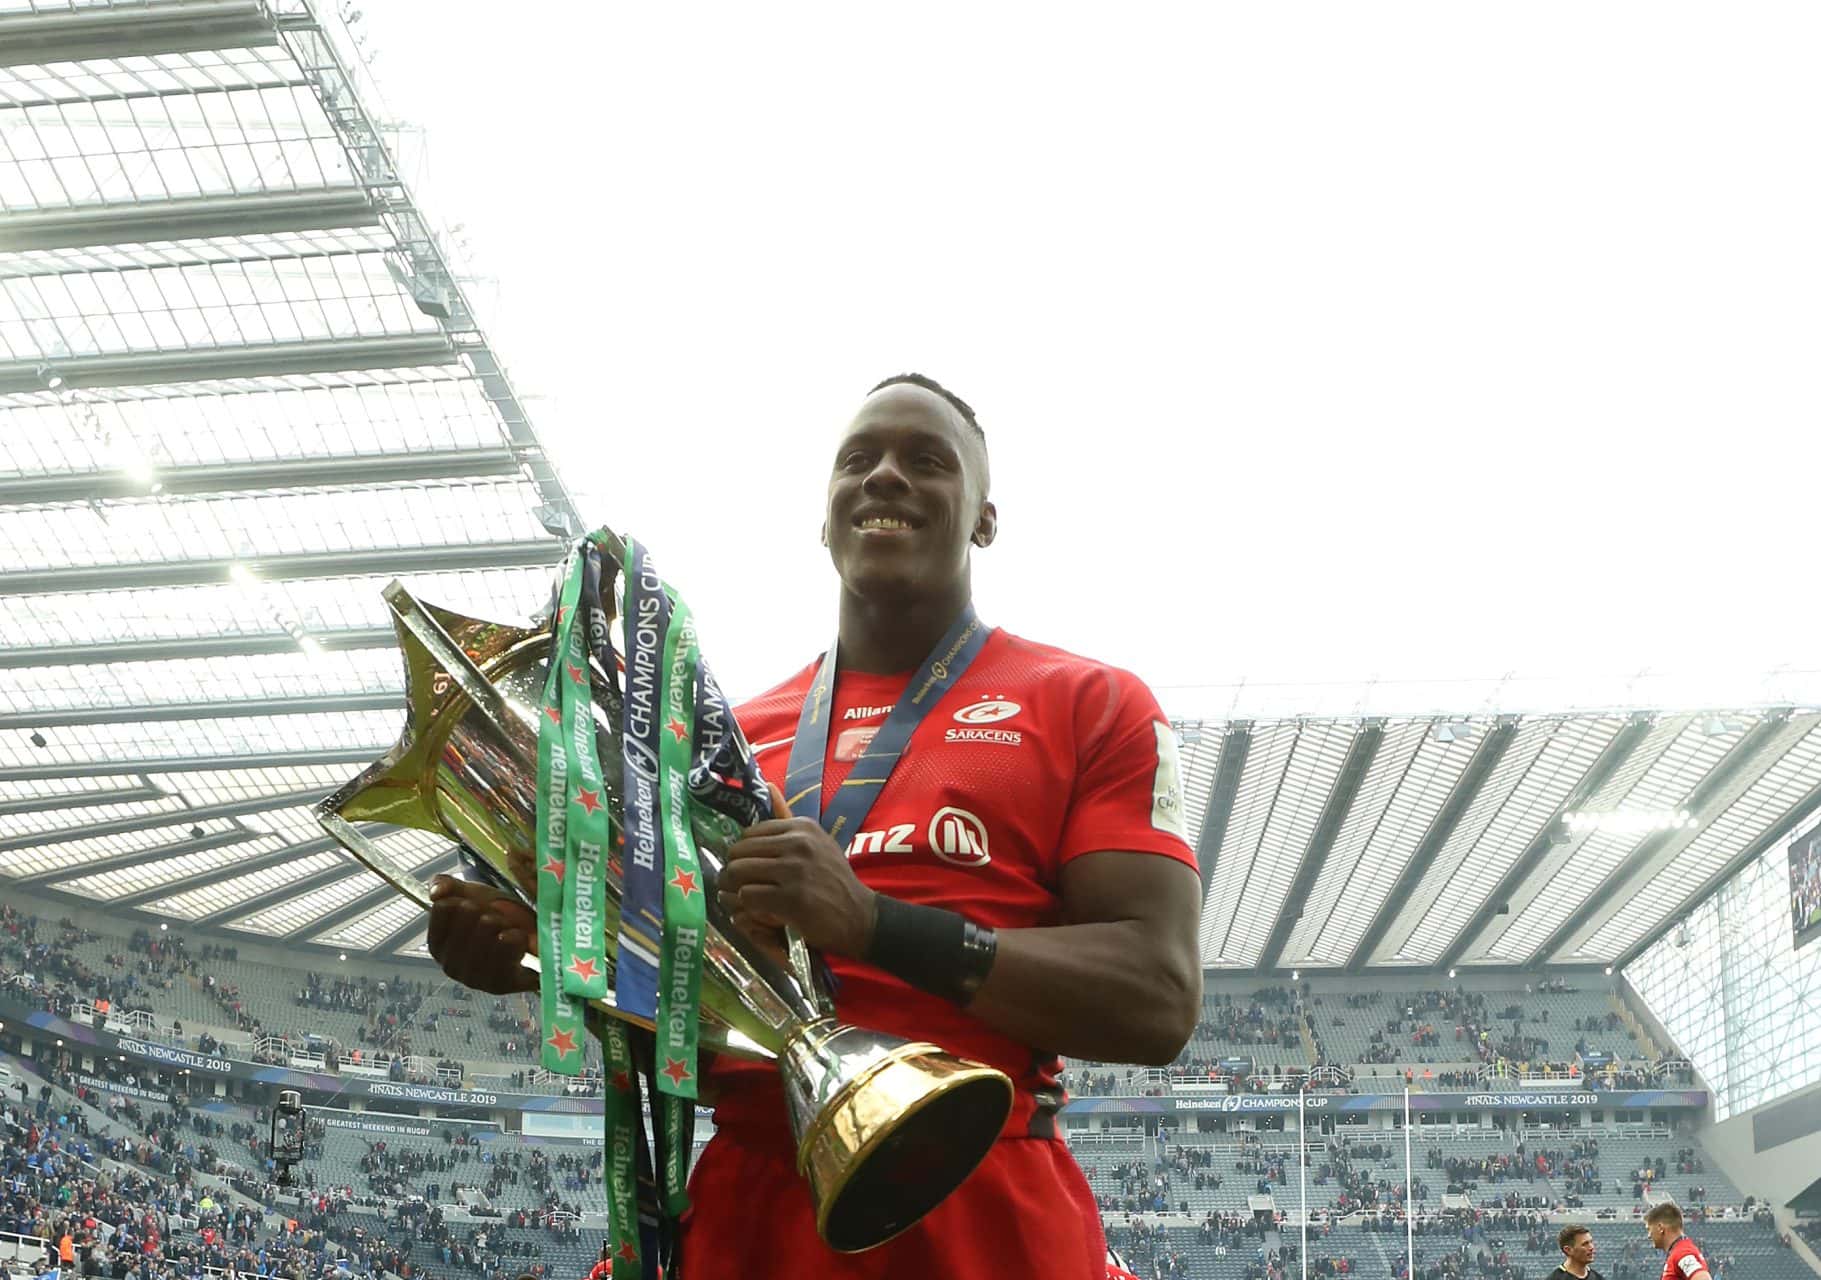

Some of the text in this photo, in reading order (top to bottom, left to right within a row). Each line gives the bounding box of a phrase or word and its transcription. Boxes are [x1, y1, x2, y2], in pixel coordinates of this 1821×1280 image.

[630, 597, 661, 738] CHAMPIONS
[843, 704, 896, 720] Allian
[944, 728, 1022, 744] SARACENS
[634, 777, 655, 871] Heineken
[575, 839, 601, 949] Heineken
[668, 925, 699, 1049] Heineken
[148, 1045, 204, 1068] NEWCASTLE
[205, 1058, 232, 1073] 2019
[79, 1075, 169, 1103] GREATEST WEEKEND IN RUGBY
[405, 1088, 468, 1102] NEWCASTLE
[470, 1094, 498, 1105] 2019
[1503, 1095, 1569, 1106] NEWCASTLE
[1570, 1094, 1598, 1105] 2019
[1175, 1099, 1221, 1110] Heineken
[1306, 1097, 1328, 1108] CUP
[326, 1118, 361, 1130] GREATEST
[362, 1123, 396, 1134] WEEKEND
[397, 1126, 405, 1134] IN
[406, 1126, 431, 1136] RUGBY
[582, 1138, 596, 1146] THE
[612, 1125, 633, 1233] Heineken
